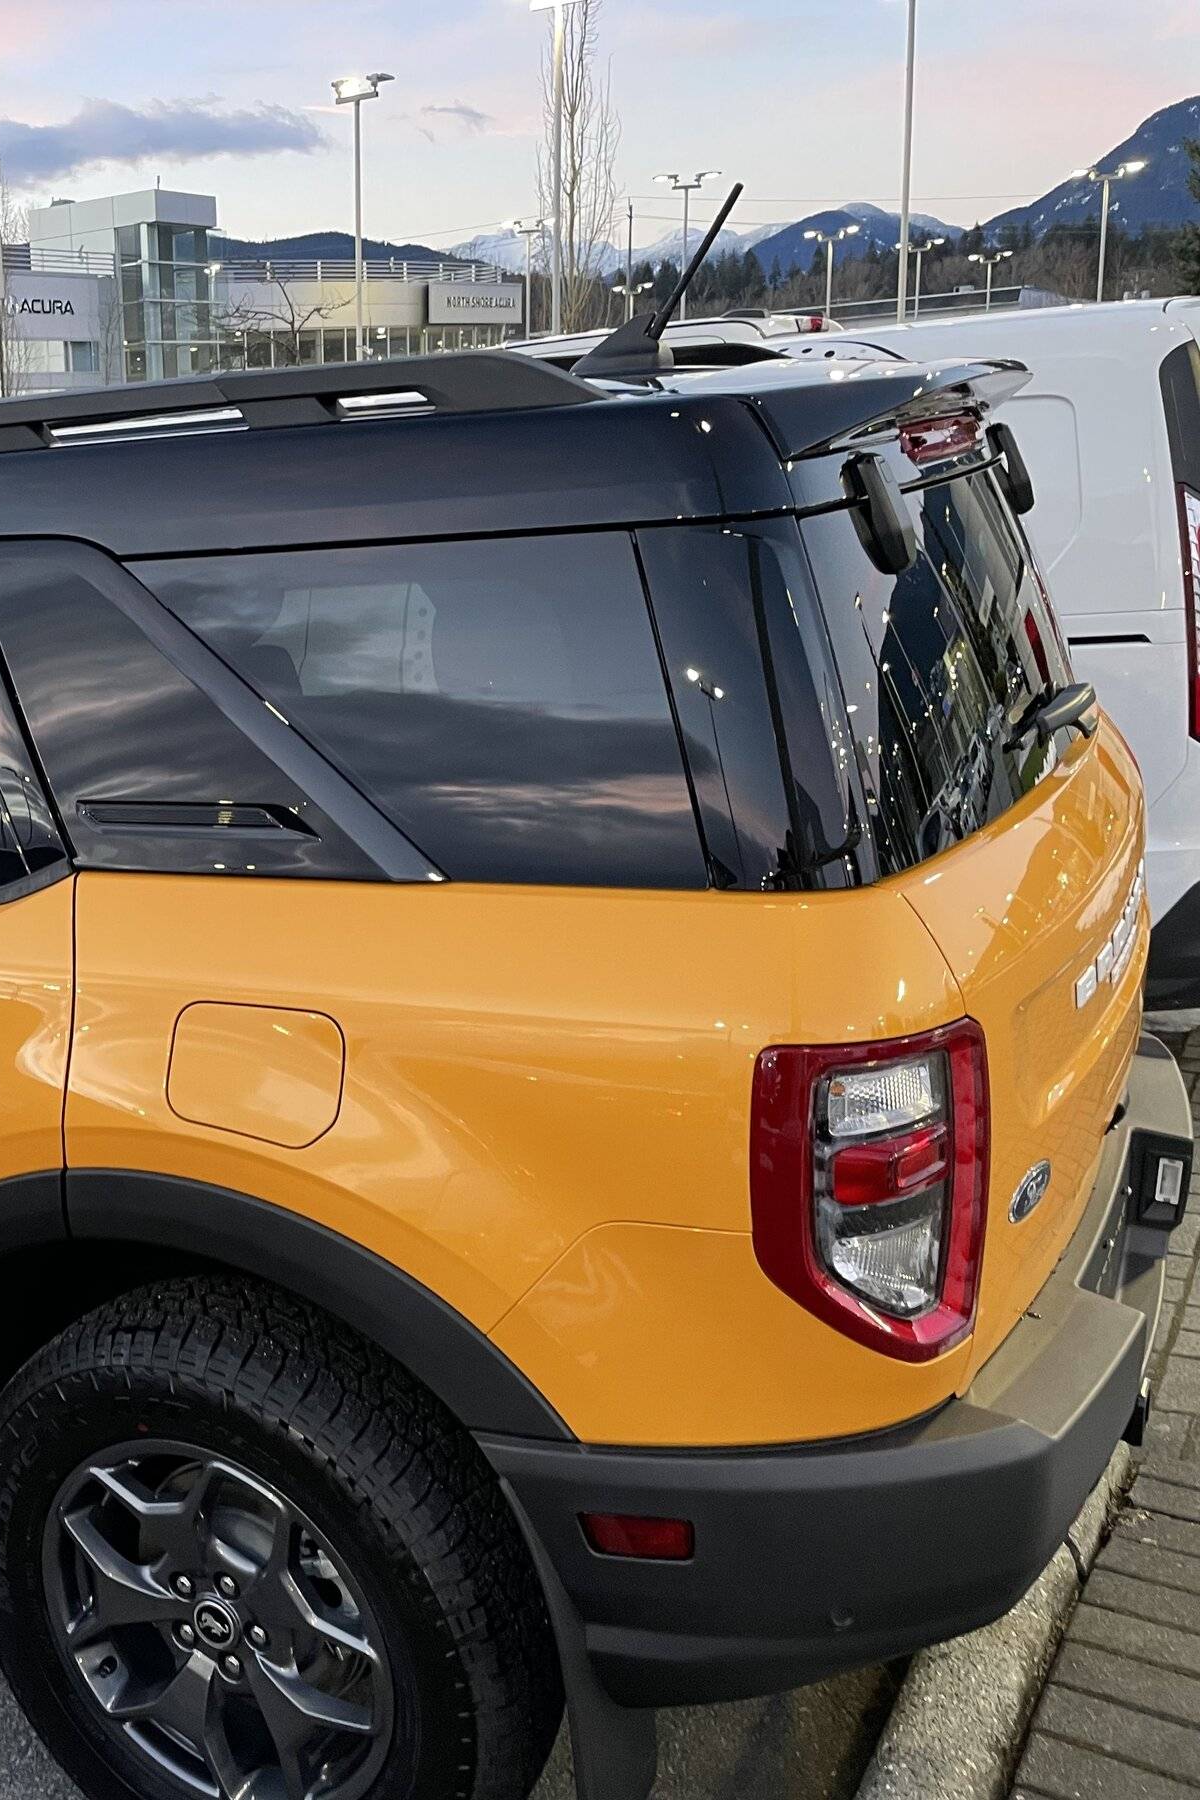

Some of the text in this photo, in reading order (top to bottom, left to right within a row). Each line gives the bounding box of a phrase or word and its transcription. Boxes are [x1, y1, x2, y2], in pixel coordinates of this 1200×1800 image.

[20, 298, 75, 315] ACURA
[446, 296, 470, 308] NORTH
[471, 296, 494, 308] SHORE
